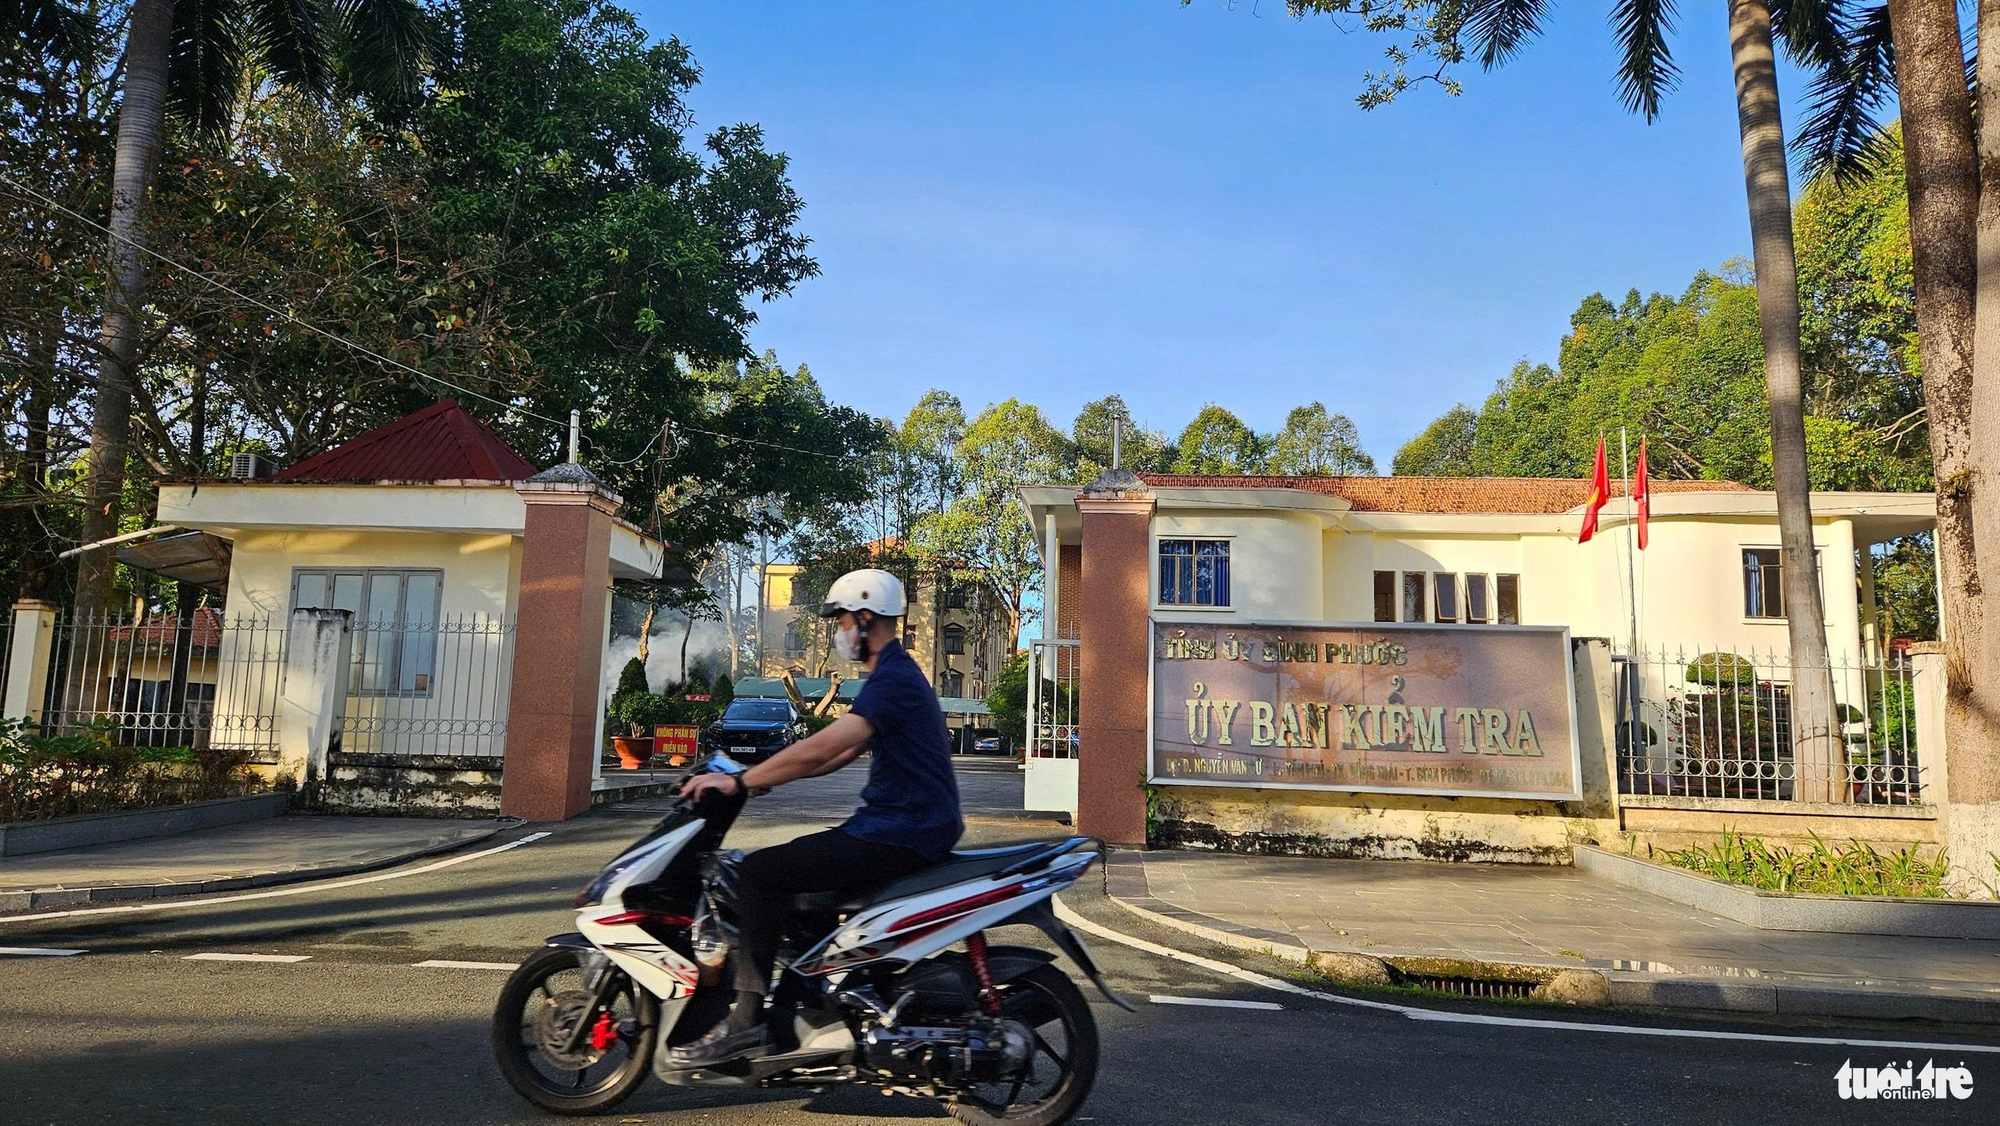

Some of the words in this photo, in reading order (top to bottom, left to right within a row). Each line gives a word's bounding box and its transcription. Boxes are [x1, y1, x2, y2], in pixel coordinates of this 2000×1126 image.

[1263, 636, 1318, 662] BÌNH
[1324, 636, 1407, 667] PHƯỚC
[1185, 681, 1241, 745] ỦY
[1249, 700, 1330, 748] BAN
[1341, 674, 1447, 753] KIỂM
[1454, 707, 1544, 757] TRA
[656, 727, 674, 738] KHÔNG
[677, 742, 688, 754] VÀO
[1194, 752, 1229, 774] NGUYỄN
